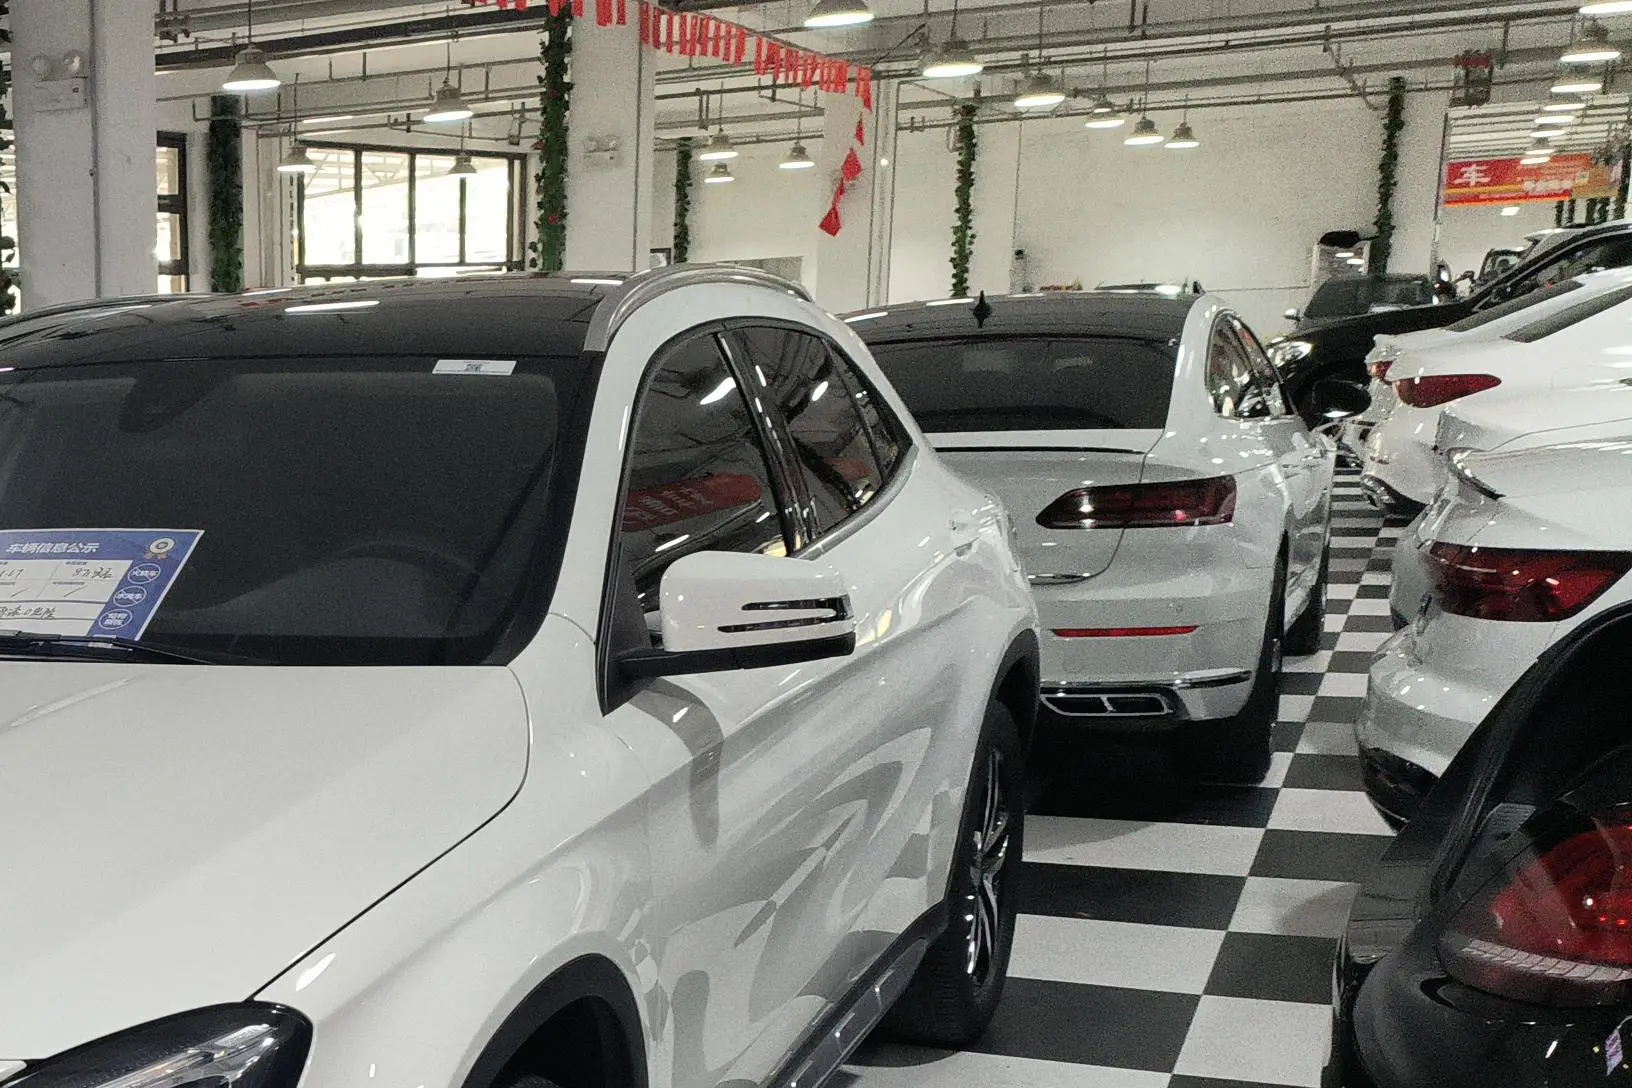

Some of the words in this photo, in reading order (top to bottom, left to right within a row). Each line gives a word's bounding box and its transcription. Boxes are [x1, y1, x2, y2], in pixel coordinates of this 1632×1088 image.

[5, 541, 100, 554] 车辆信息公示
